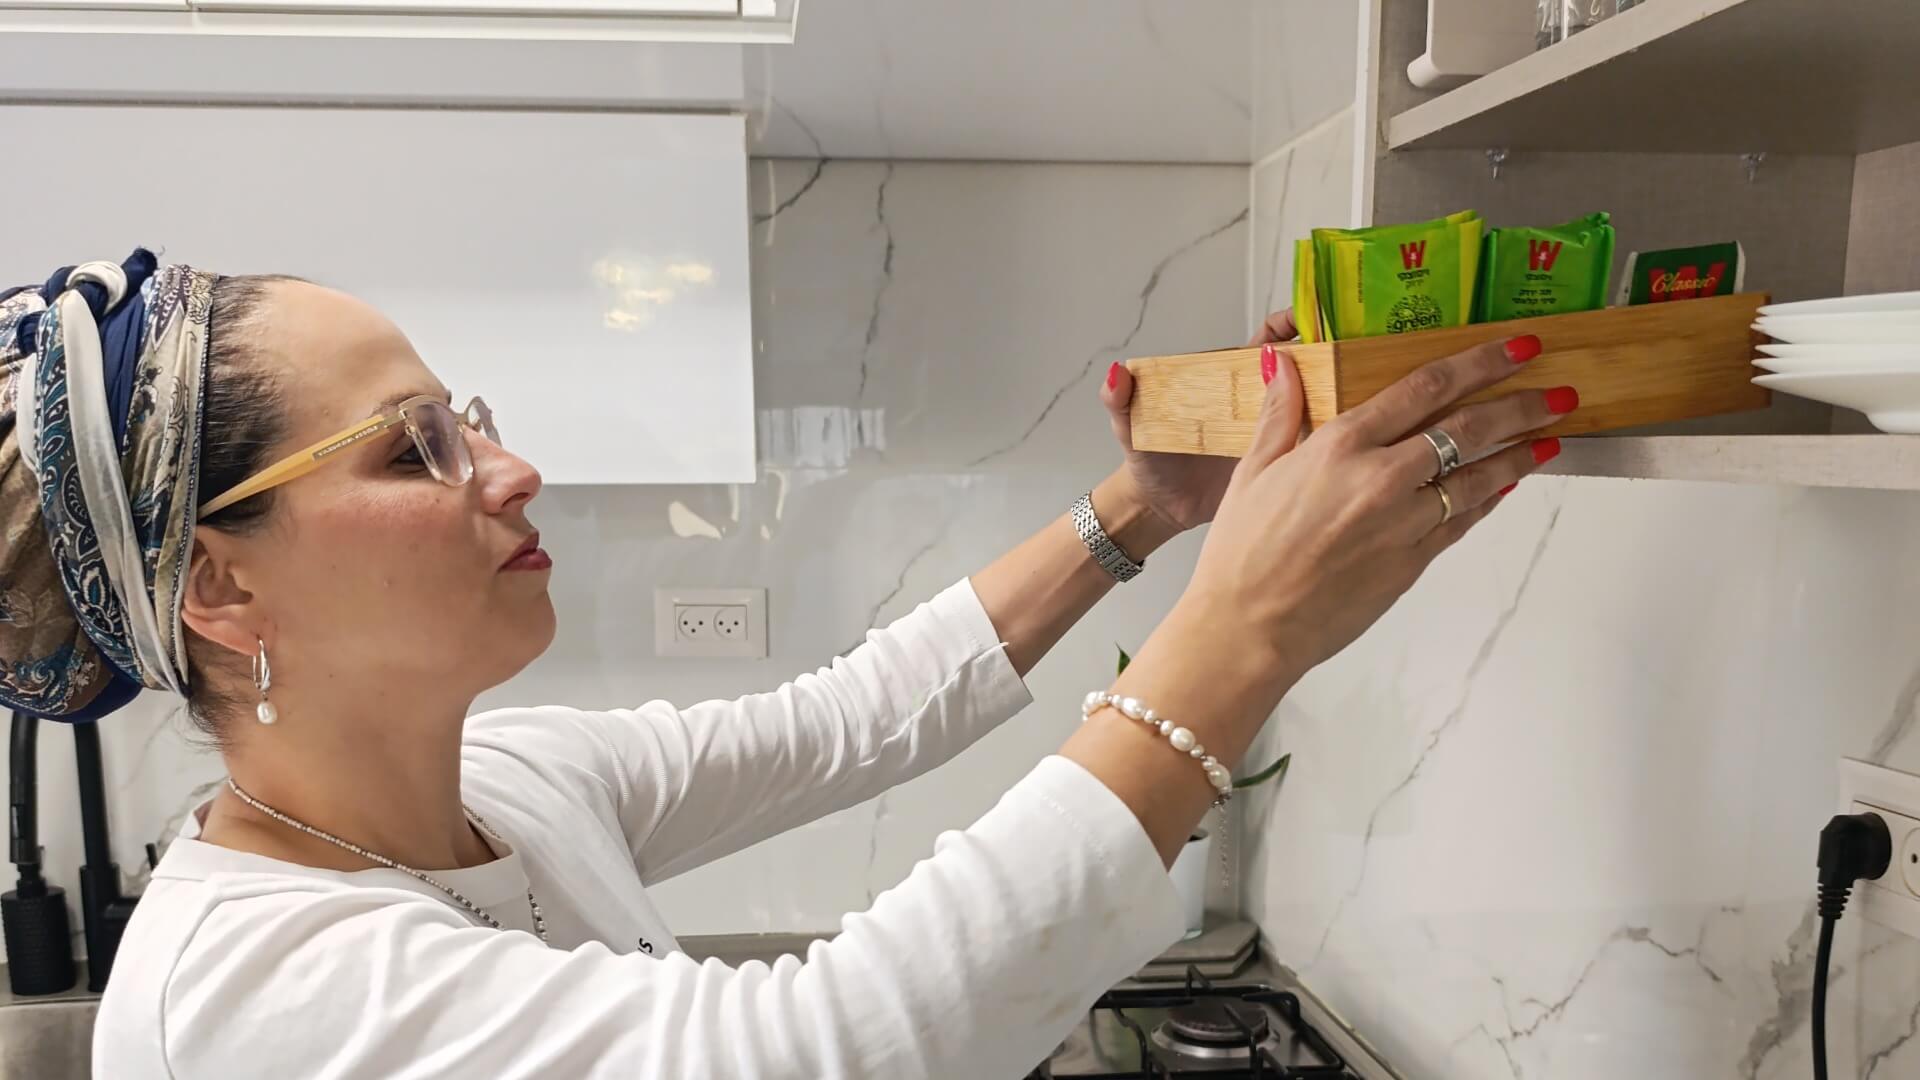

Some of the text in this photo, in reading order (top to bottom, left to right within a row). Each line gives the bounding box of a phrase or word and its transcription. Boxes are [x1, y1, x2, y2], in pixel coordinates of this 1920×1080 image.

[1399, 240, 1426, 270] W
[1529, 239, 1562, 272] W
[1651, 272, 1717, 293] Classic
[1393, 313, 1441, 333] green
